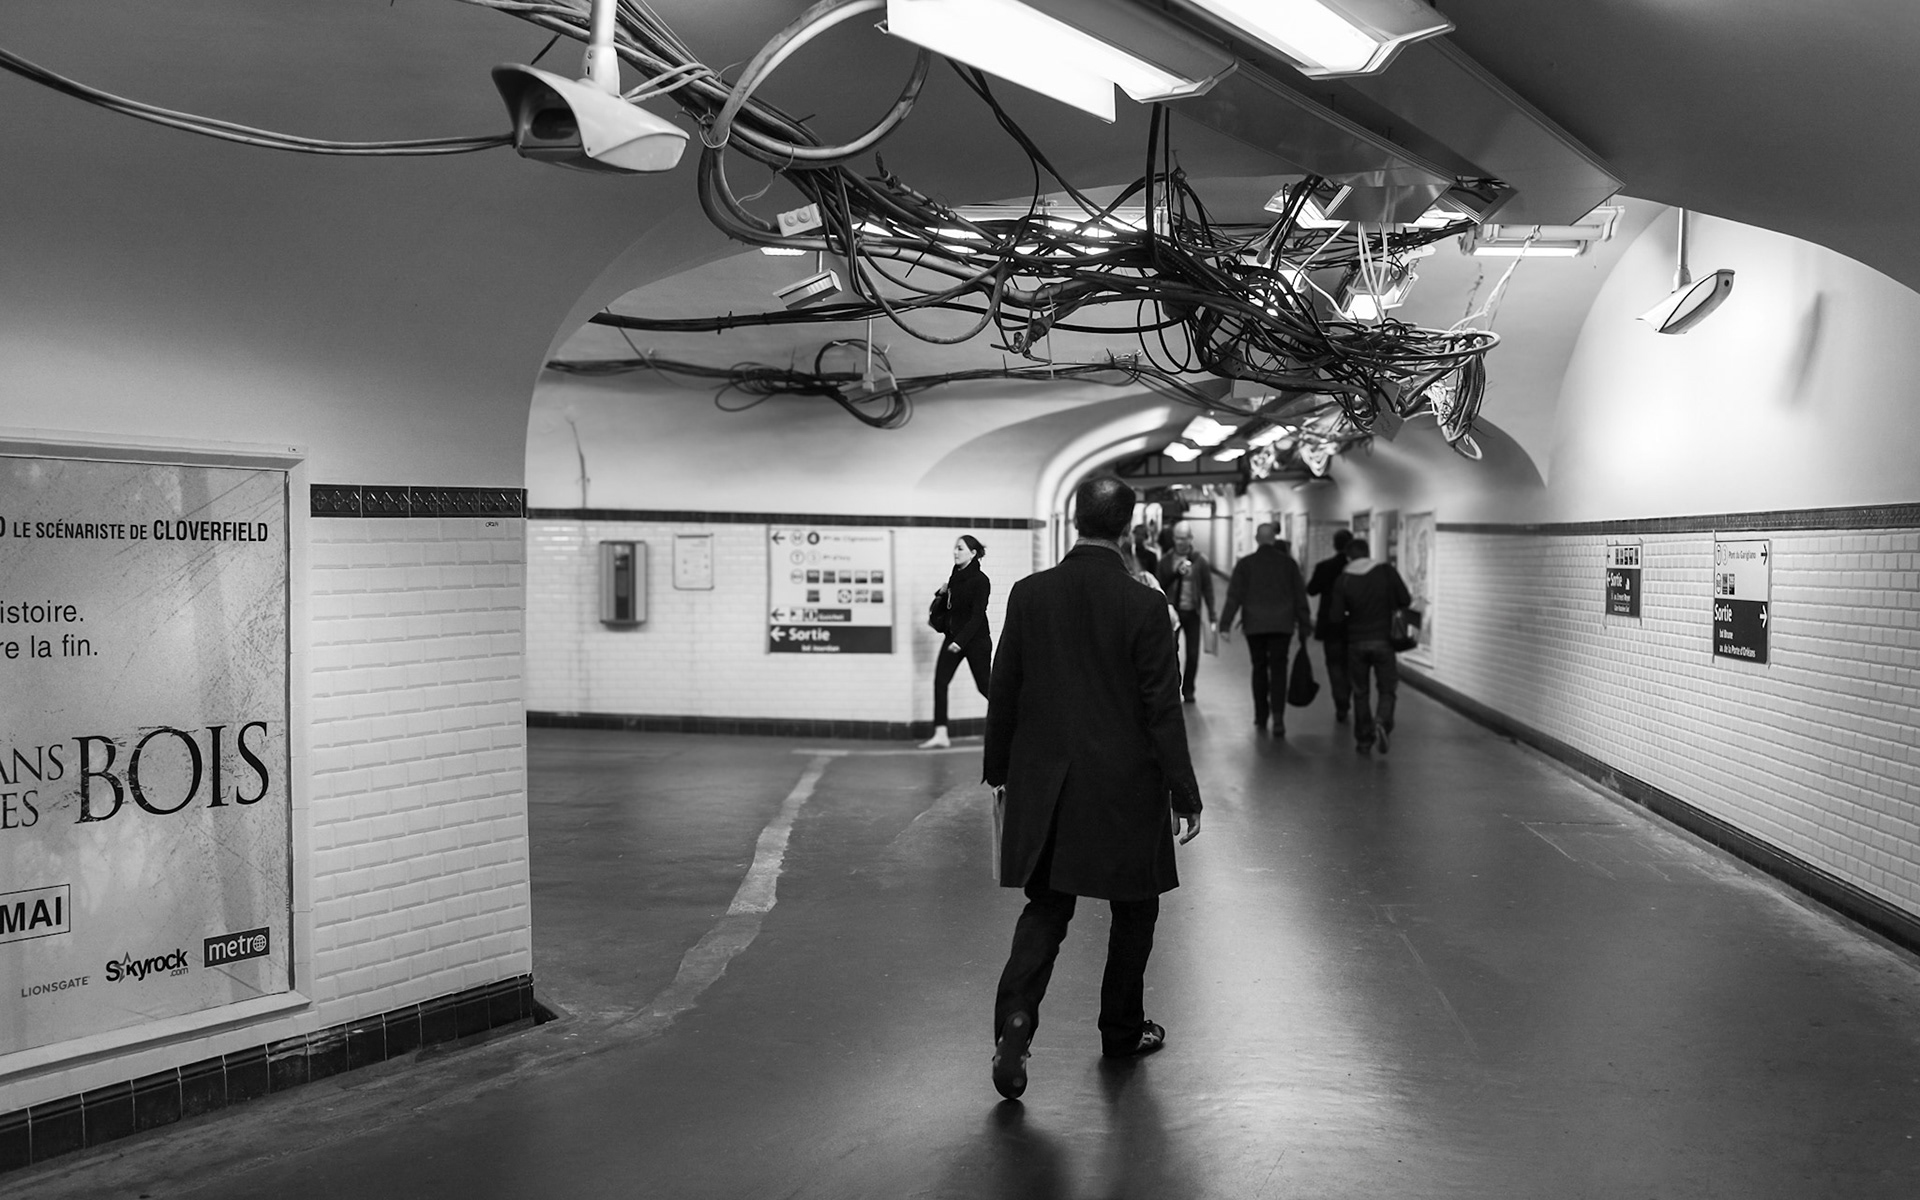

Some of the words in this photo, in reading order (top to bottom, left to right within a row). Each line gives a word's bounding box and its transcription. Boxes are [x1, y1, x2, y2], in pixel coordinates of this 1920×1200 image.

[13, 521, 31, 538] LE
[36, 519, 125, 540] SCÉNARISTE
[130, 524, 147, 540] DE
[153, 519, 268, 542] CLOVERFIELD
[1715, 604, 1732, 621] Sortie
[31, 635, 52, 658] la
[62, 633, 98, 657] fin.
[789, 627, 830, 641] Sortie
[72, 721, 270, 824] BOIS
[0, 790, 39, 829] ES
[0, 896, 62, 934] MAI
[105, 949, 189, 982] Skyrock
[21, 976, 90, 998] LIONSGATE
